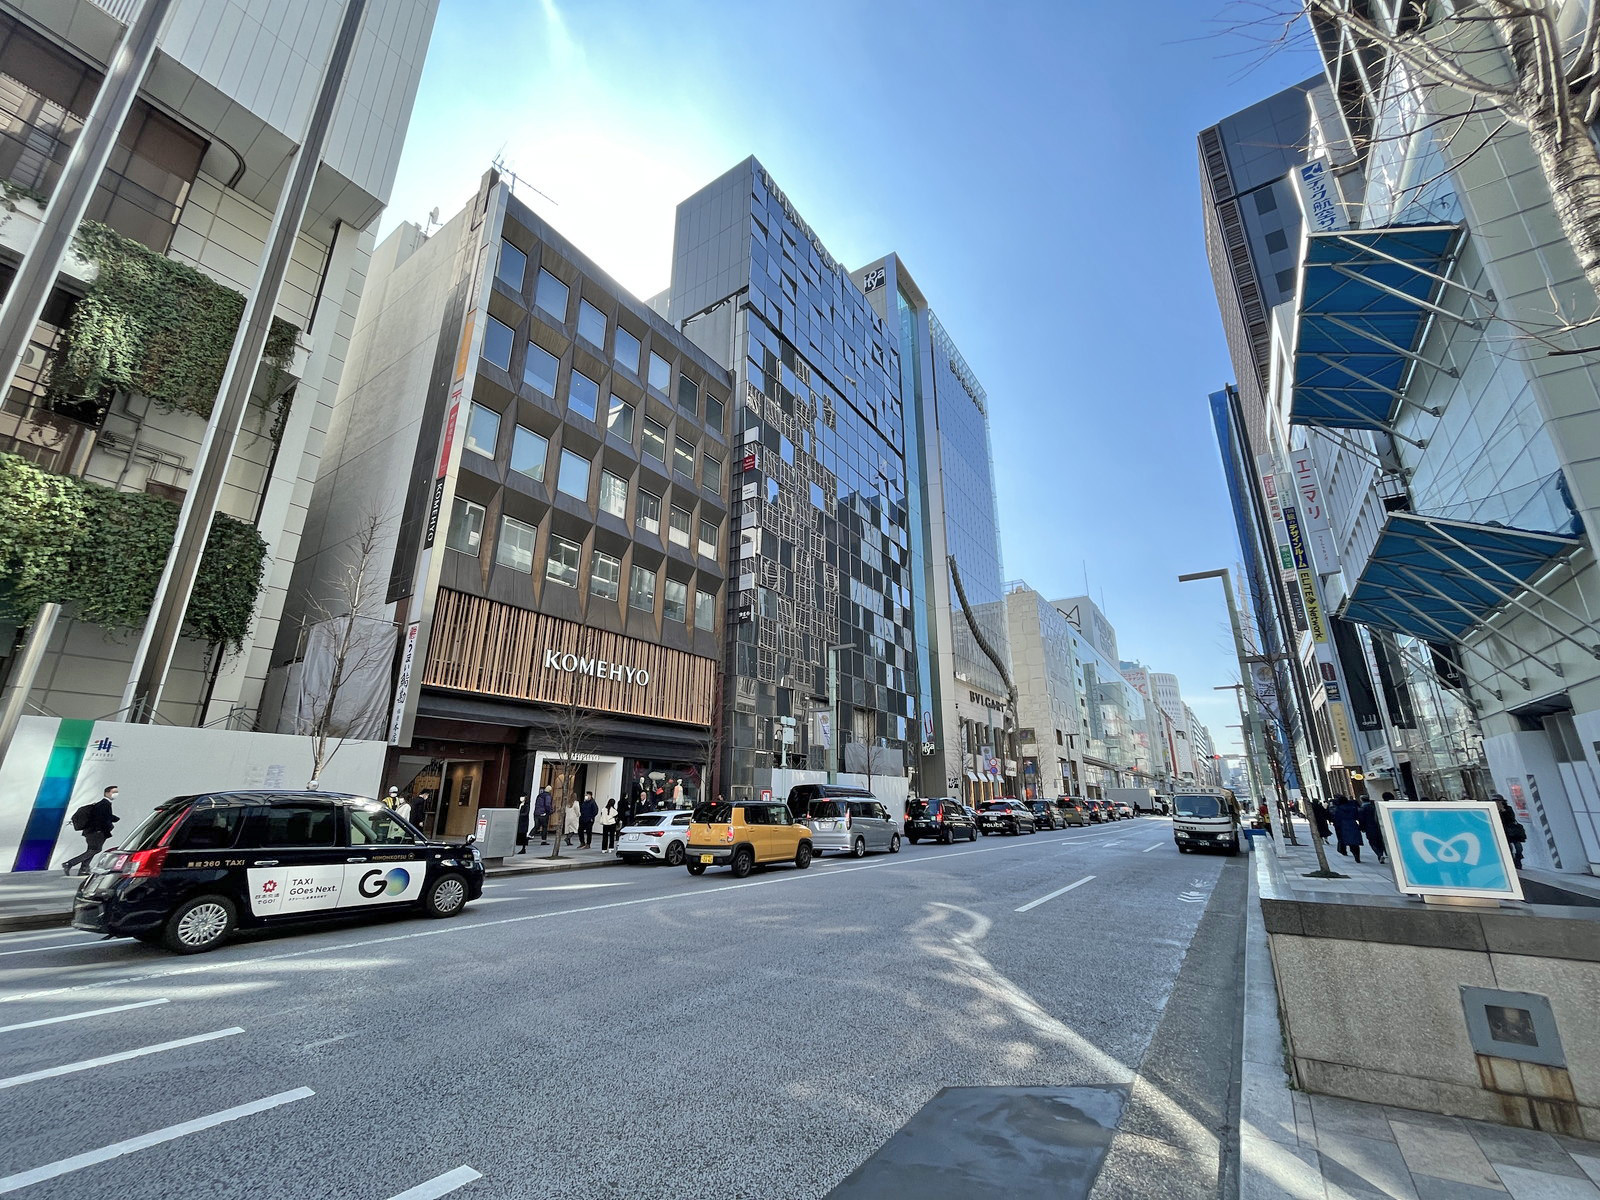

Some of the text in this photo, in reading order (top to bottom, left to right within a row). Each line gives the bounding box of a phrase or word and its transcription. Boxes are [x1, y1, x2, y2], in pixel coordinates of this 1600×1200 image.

[1297, 460, 1320, 519] エニマリ
[427, 482, 443, 541] KOMEHYO
[1301, 572, 1314, 597] ELITE
[544, 649, 649, 687] KOMEHYO
[289, 885, 337, 896] GOes Next.
[292, 878, 314, 886] TAXI
[358, 867, 411, 899] GO
